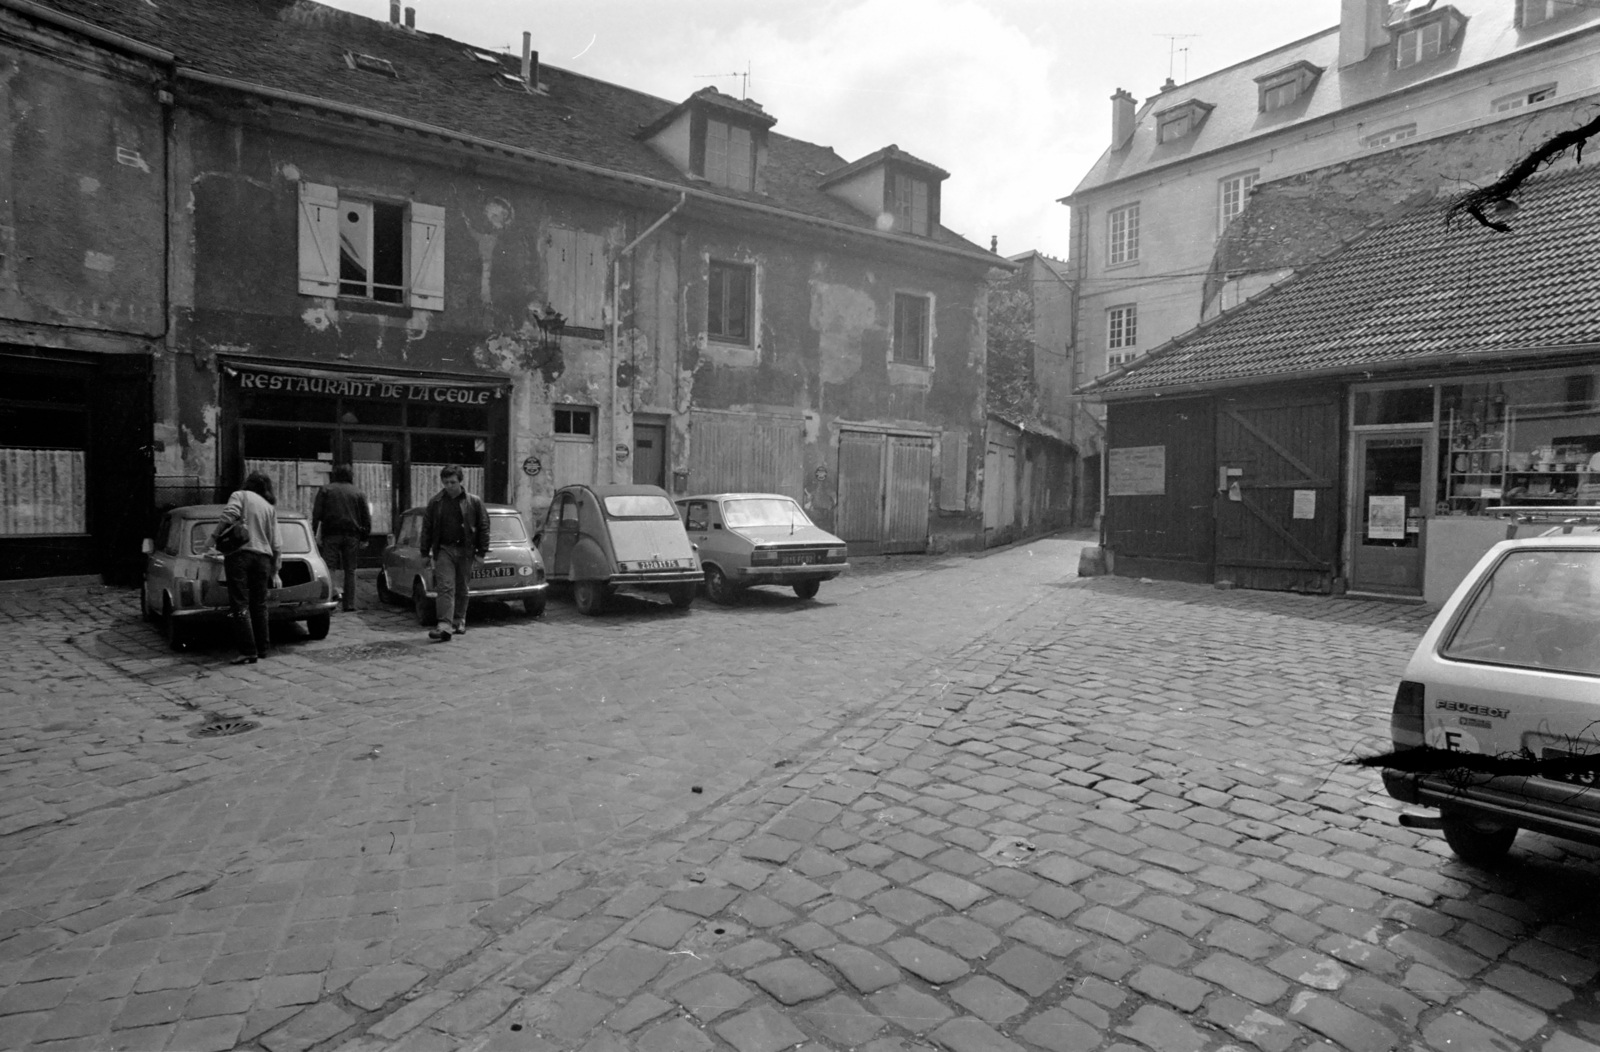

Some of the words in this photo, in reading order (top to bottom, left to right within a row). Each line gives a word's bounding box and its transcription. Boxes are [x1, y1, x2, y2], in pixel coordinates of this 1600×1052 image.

[240, 373, 376, 397] RESTAURANT
[380, 383, 403, 398] DE
[408, 386, 429, 401] LA
[434, 387, 490, 404] GEOLE
[523, 566, 529, 575] F
[1435, 699, 1510, 719] PEUGEOT
